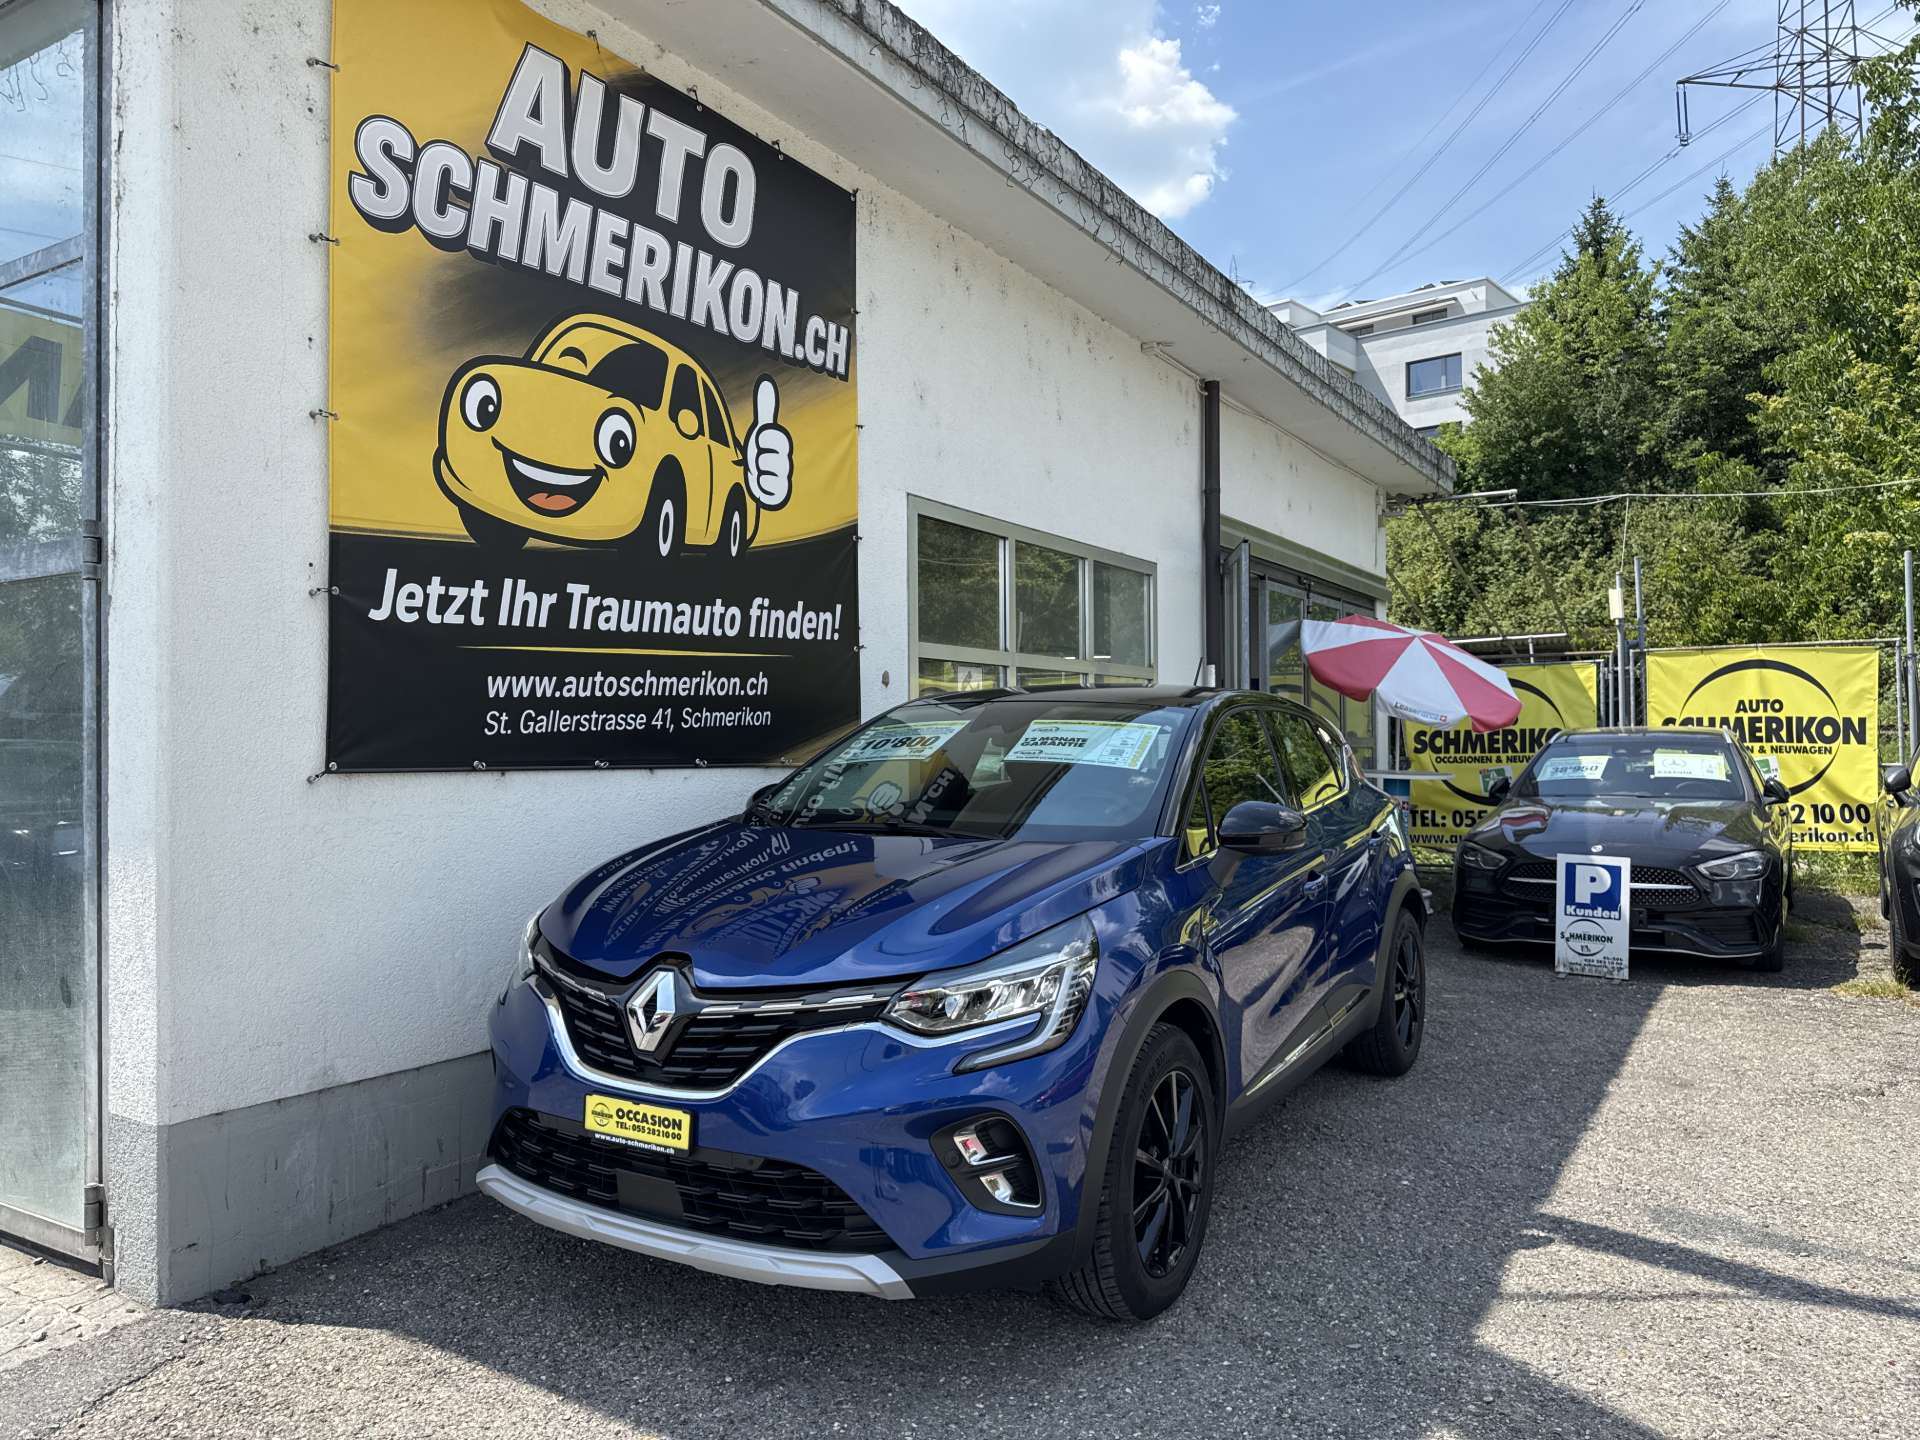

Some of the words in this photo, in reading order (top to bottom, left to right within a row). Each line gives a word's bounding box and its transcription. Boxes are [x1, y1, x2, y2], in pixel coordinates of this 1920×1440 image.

[487, 43, 757, 249] AUTO
[350, 116, 849, 376] SCHMERIKON.CH
[368, 567, 489, 626] Jetzt
[498, 578, 557, 628] Ihr
[566, 583, 741, 637] Traumauto
[748, 597, 841, 641] finden!
[487, 670, 769, 698] www.autoschmerikon.ch
[1735, 699, 1784, 714] AUTO
[484, 711, 512, 735] St.
[519, 710, 647, 734] Gallerstrasse
[652, 708, 675, 733] 41,
[681, 707, 772, 729] Schmerikon
[861, 735, 941, 751] 10'800
[1020, 741, 1087, 749] GARANTIE
[1038, 736, 1089, 744] MONATE
[1435, 755, 1493, 764] OCCASIONEN
[1495, 755, 1503, 764] &
[1758, 746, 1767, 754] &
[1770, 745, 1833, 755] NEUWAGEN
[1410, 809, 1447, 828] TEL:
[1811, 804, 1835, 824] 10
[1840, 804, 1871, 824] 00
[1575, 864, 1612, 904] P
[1566, 905, 1620, 920] Kunden
[615, 1108, 683, 1132] OCCASION
[615, 1120, 631, 1130] TEL:
